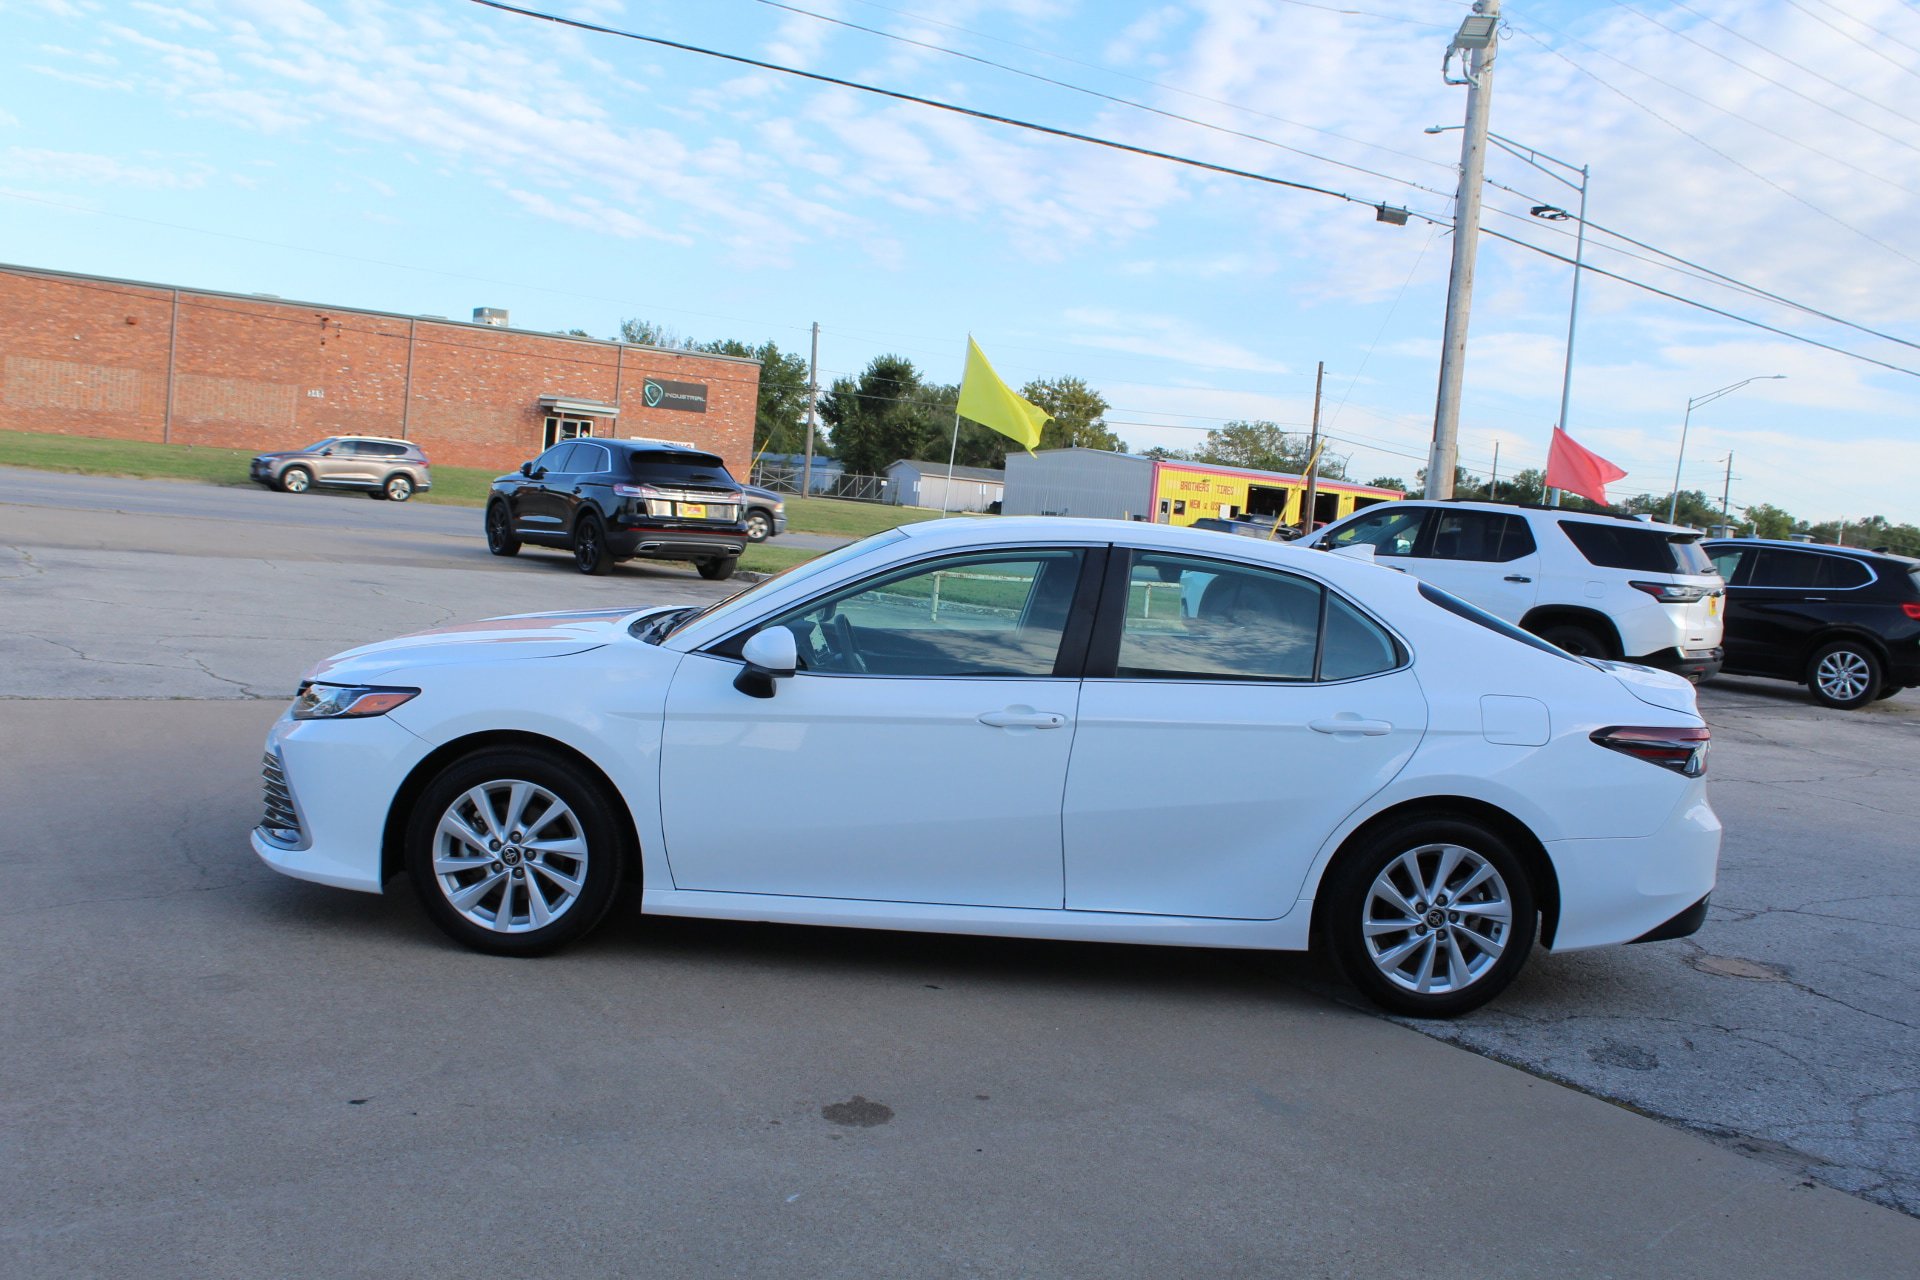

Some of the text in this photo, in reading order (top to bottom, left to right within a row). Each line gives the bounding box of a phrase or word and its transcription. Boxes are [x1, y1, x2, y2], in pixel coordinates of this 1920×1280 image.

[665, 392, 706, 402] INDUSTRIAL
[1180, 481, 1235, 495] BROTHERS TIRES
